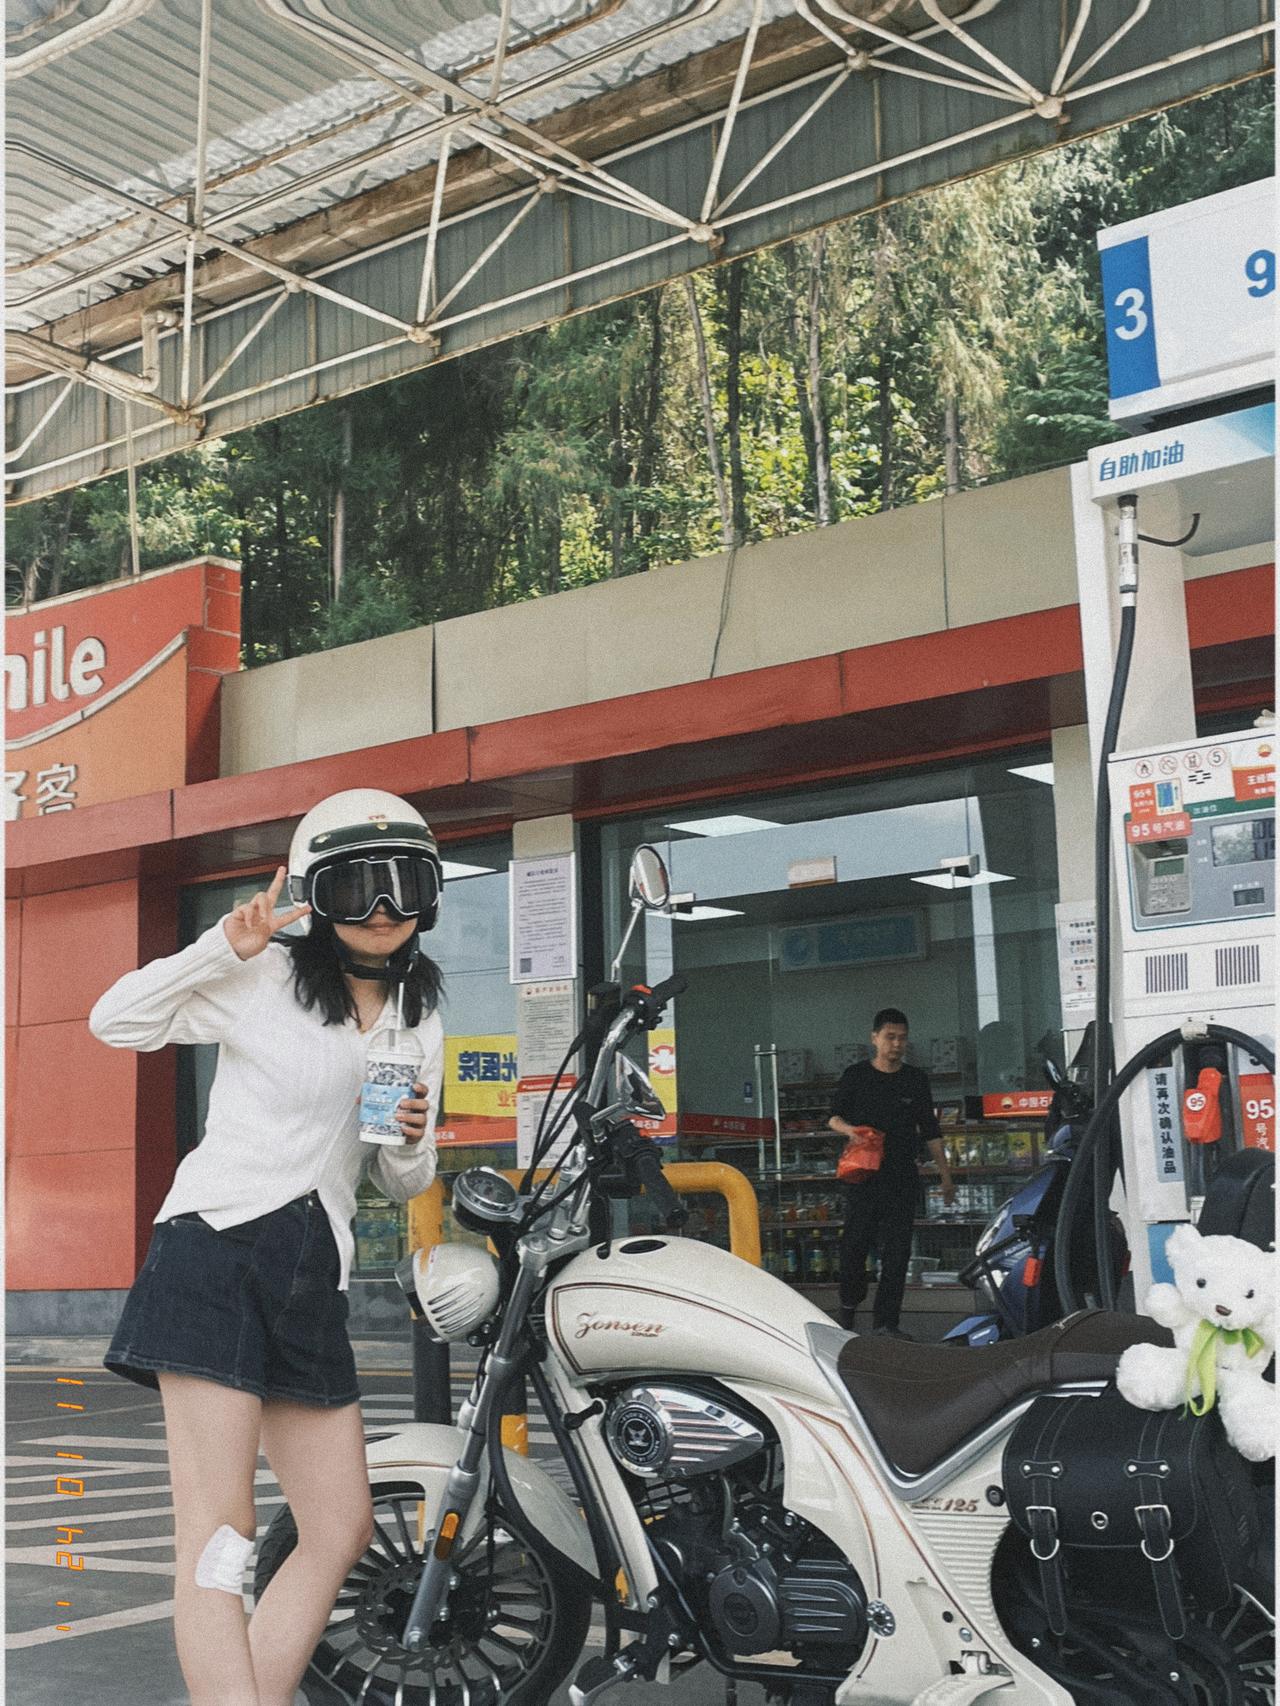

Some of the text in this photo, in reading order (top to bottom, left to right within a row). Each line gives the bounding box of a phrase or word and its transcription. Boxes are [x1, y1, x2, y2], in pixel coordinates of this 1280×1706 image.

[1244, 249, 1275, 298] 9
[1114, 287, 1148, 340] 3
[1099, 440, 1185, 482] 自助加油
[1154, 1073, 1177, 1175] 请再次确认油品
[1189, 1096, 1204, 1108] 95
[1245, 1099, 1275, 1120] 95
